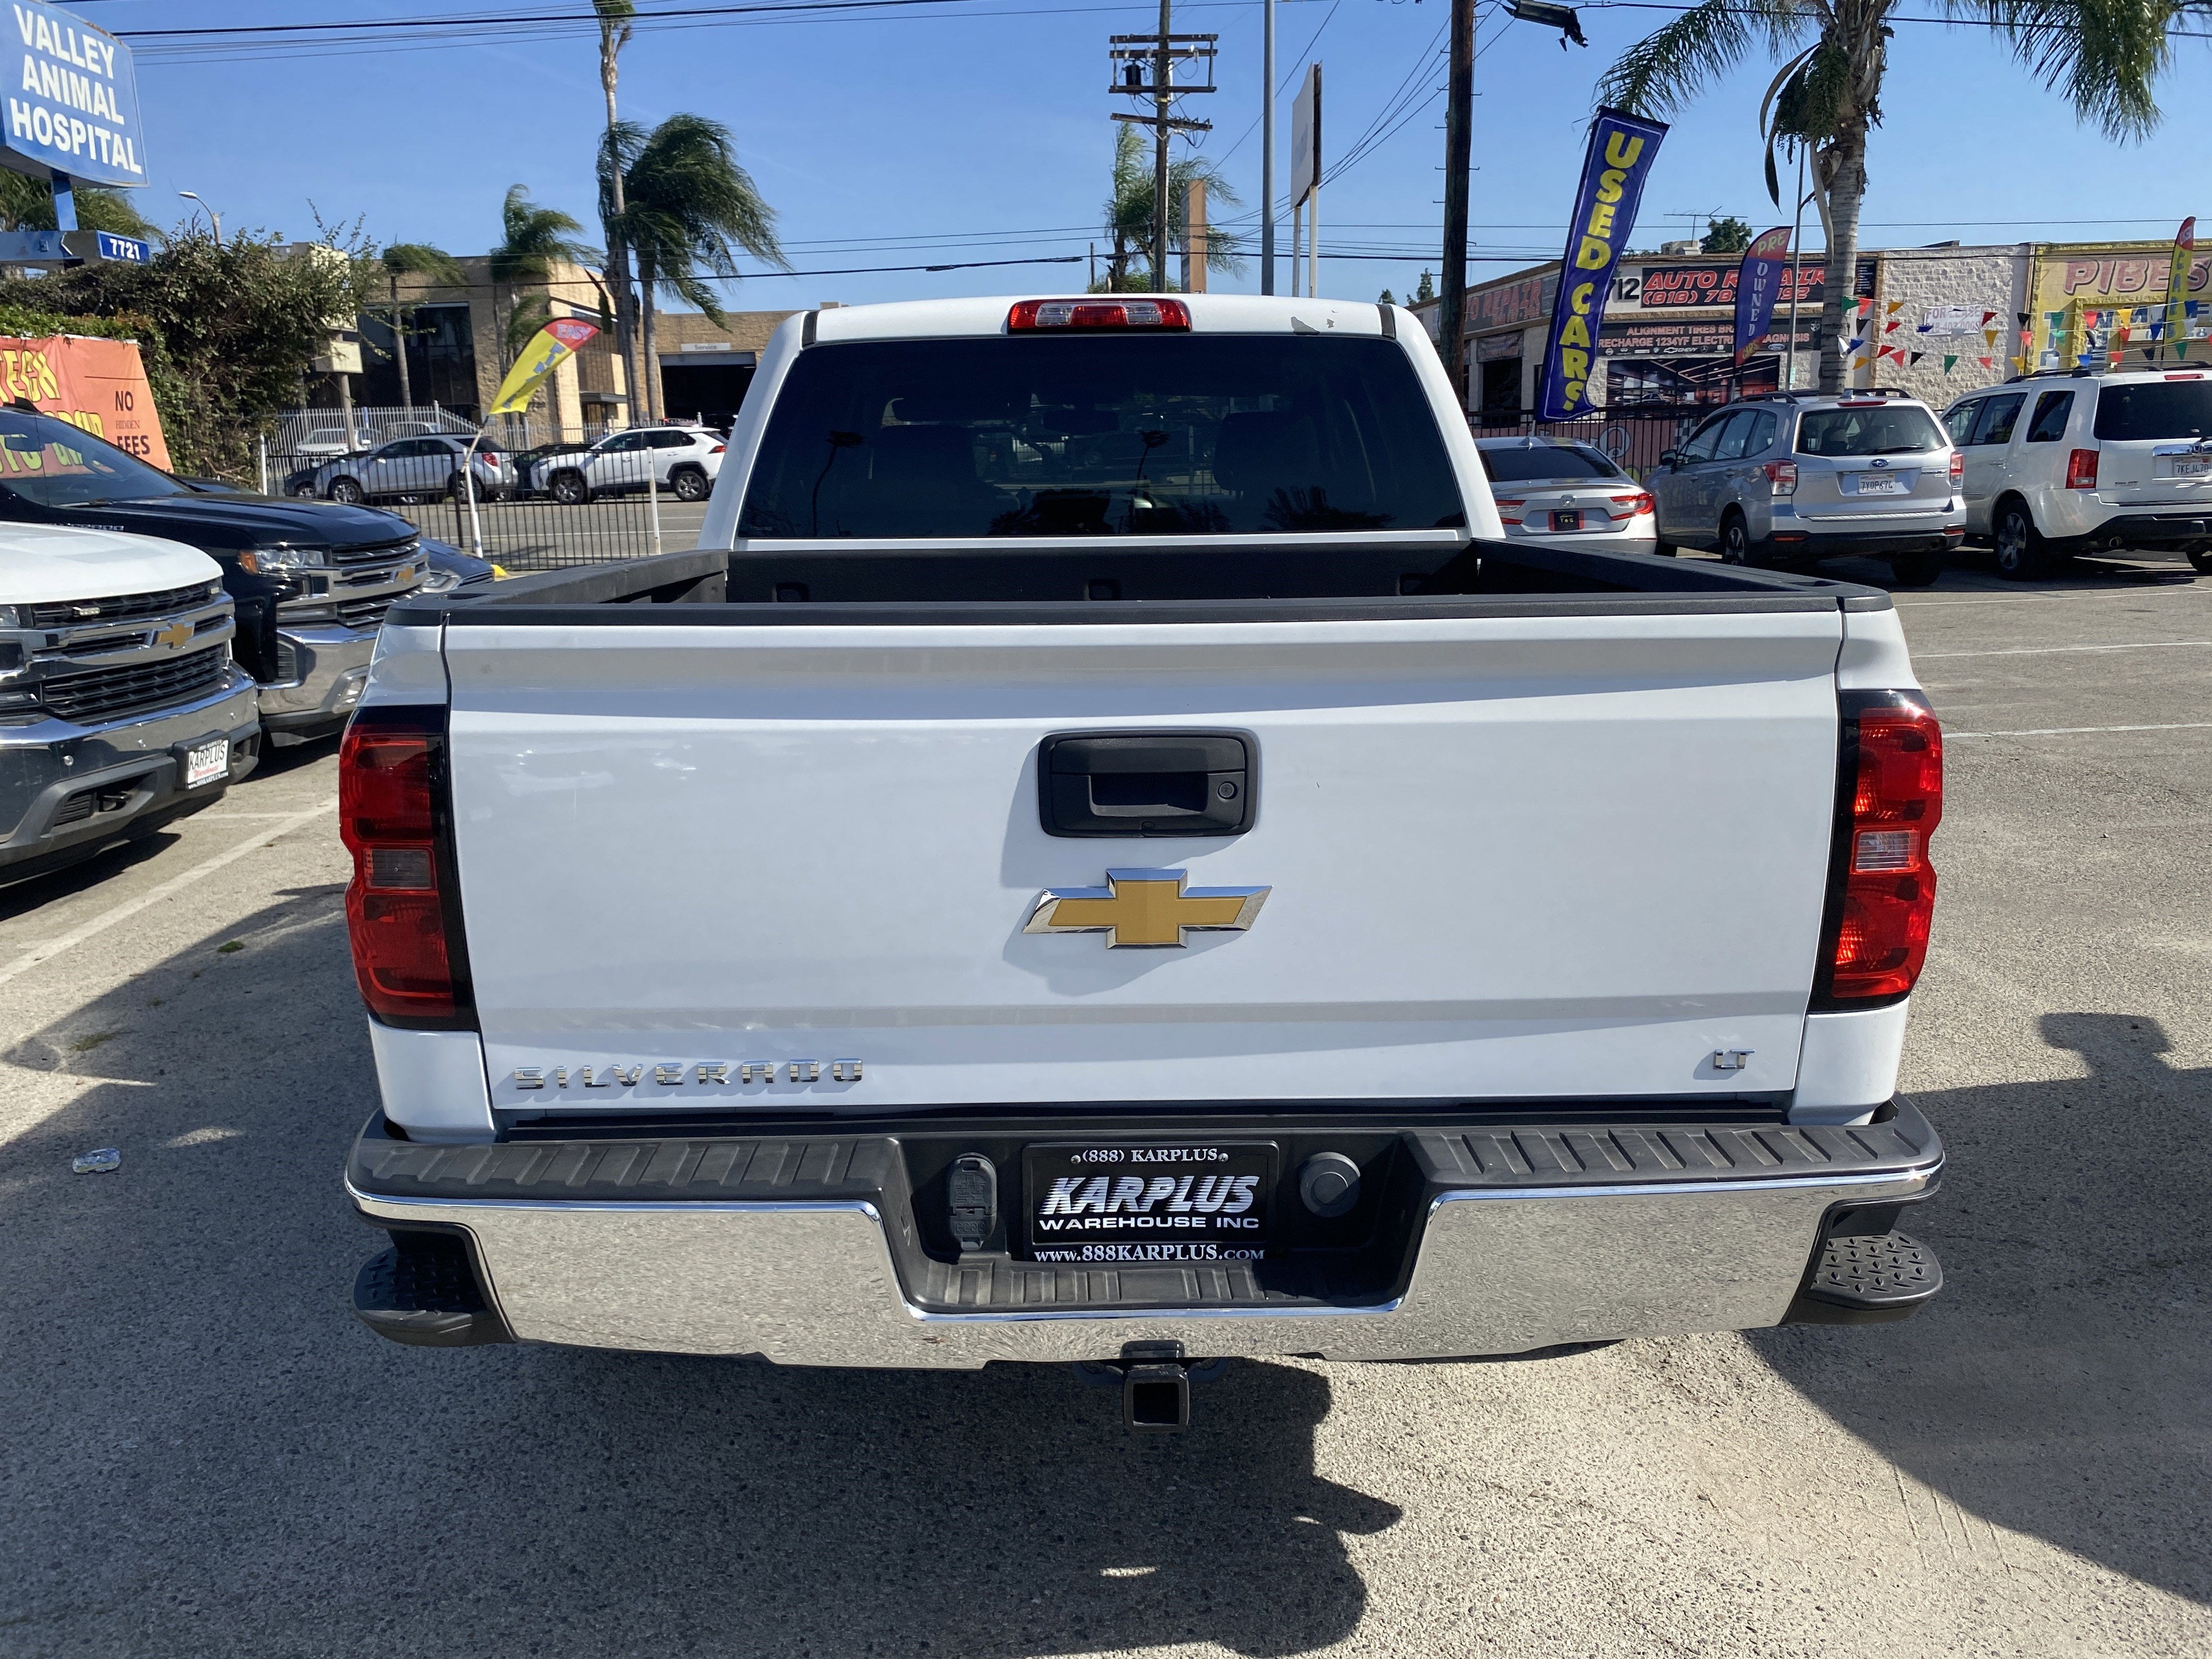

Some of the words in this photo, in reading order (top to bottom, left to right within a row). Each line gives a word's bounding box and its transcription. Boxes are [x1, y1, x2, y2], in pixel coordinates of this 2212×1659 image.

[14, 4, 115, 79] VALLEY
[22, 55, 125, 126] ANIMAL
[10, 97, 142, 174] HOSPITAL
[1575, 131, 1644, 270] USED
[109, 238, 140, 260] 7721
[1757, 230, 1787, 256] PRE
[1644, 270, 1717, 290] AUTO
[1722, 267, 1825, 289] RAIR
[2063, 259, 2211, 295] PIBES
[1482, 280, 1541, 318] REPAIR
[1643, 290, 1698, 305] (818)
[1748, 261, 1769, 337] OWNED
[1926, 307, 1946, 319] FOR
[556, 324, 591, 341] EASY
[1598, 337, 1654, 348] RECHARGE
[1691, 335, 1734, 346] ELECTRI
[1626, 326, 1685, 336] ALIGNMENT
[1688, 325, 1716, 335] TIRES
[1558, 281, 1595, 411] CARS
[115, 391, 134, 411] NO
[115, 420, 140, 430] HIDDEN
[116, 435, 150, 455] FEES
[188, 744, 225, 772] KARPLUS
[1712, 1048, 1756, 1070] LT
[515, 1058, 864, 1090] SILVERADO
[1082, 1149, 1125, 1164] (888)
[1131, 1148, 1218, 1163] KARPLUS
[1038, 1176, 1260, 1215] KARPLUS
[1039, 1217, 1207, 1230] WAREHOUSE
[1216, 1217, 1260, 1229] INC
